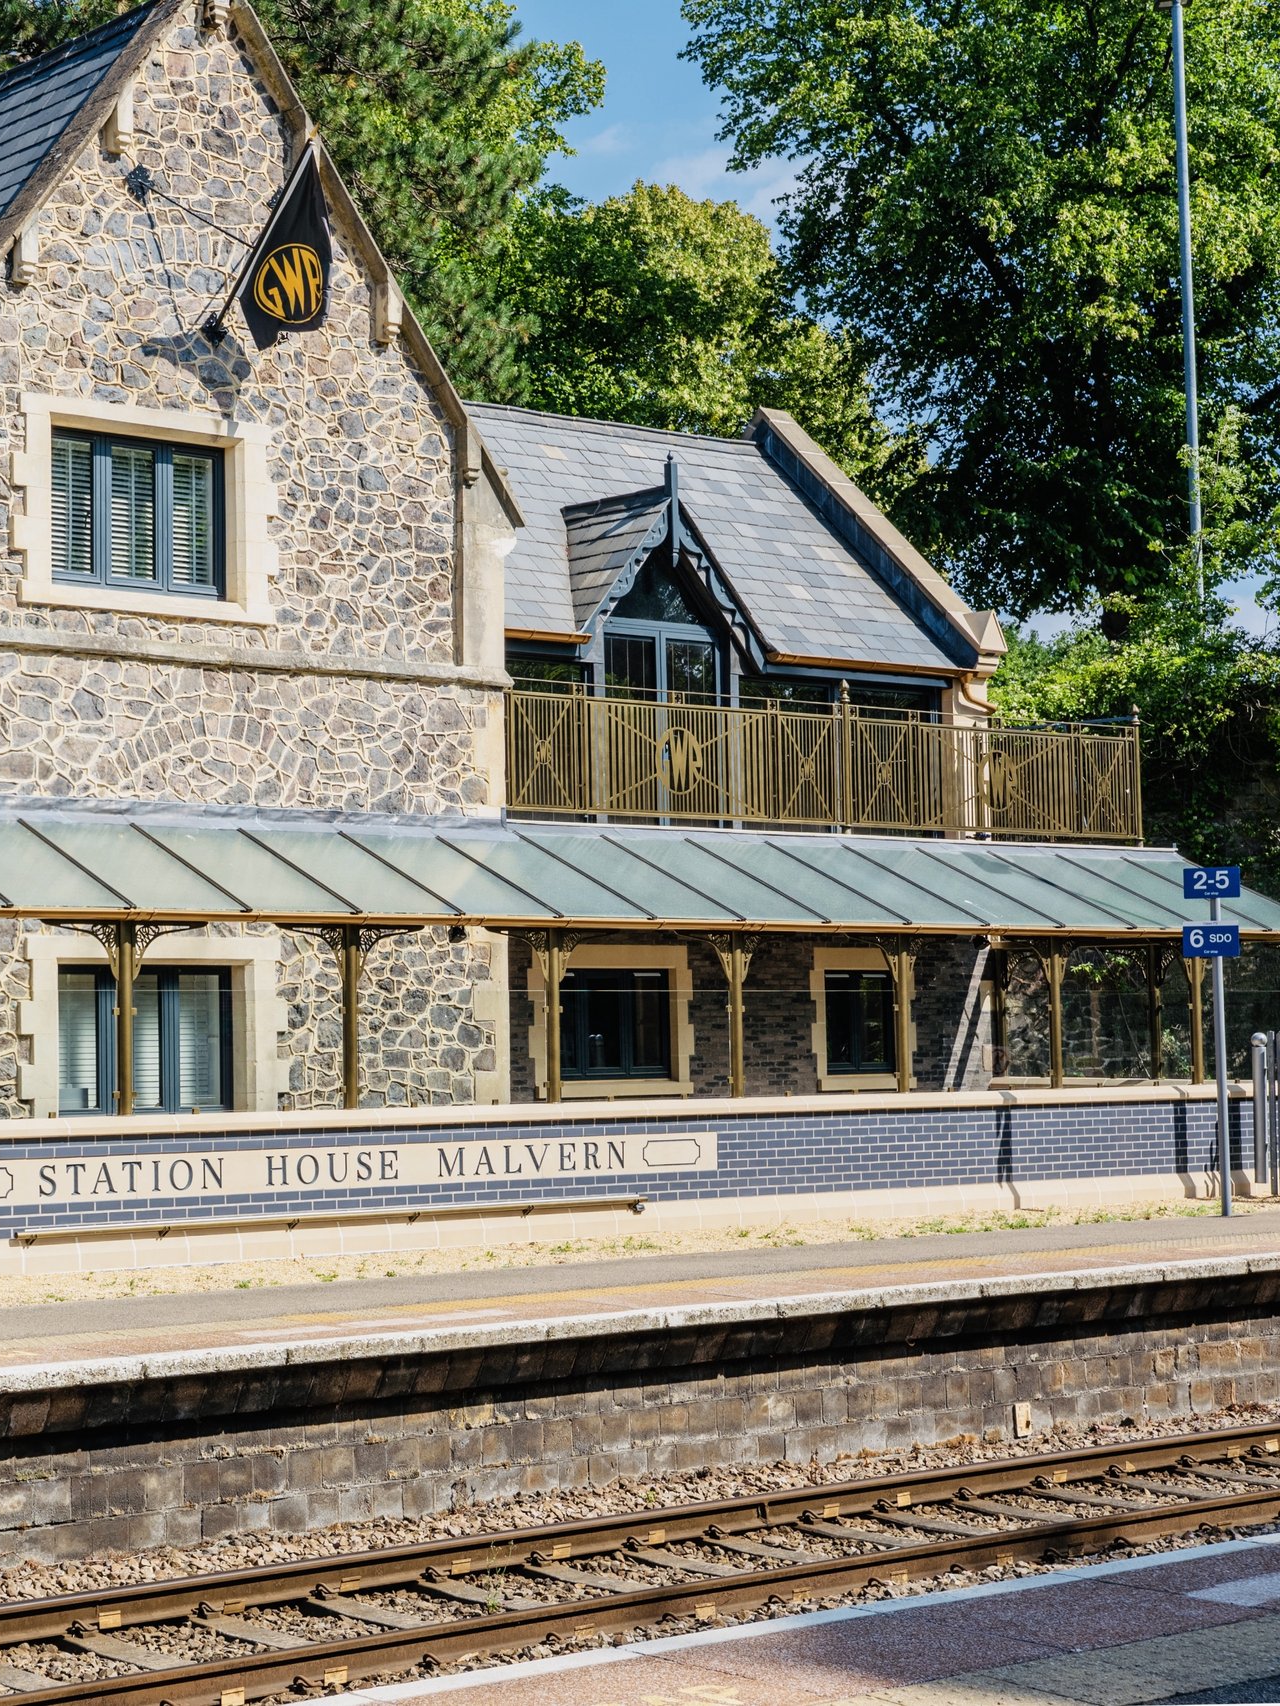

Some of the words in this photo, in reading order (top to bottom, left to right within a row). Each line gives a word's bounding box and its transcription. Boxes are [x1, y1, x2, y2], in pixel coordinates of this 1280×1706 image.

[257, 246, 321, 318] GWR
[655, 727, 703, 794] GWR
[1193, 870, 1230, 890] 2-5
[1189, 929, 1204, 948] 6
[1209, 933, 1232, 943] SDO
[38, 1157, 225, 1198] STATION
[265, 1149, 400, 1186] HOUSE
[437, 1140, 627, 1177] MALVERN
